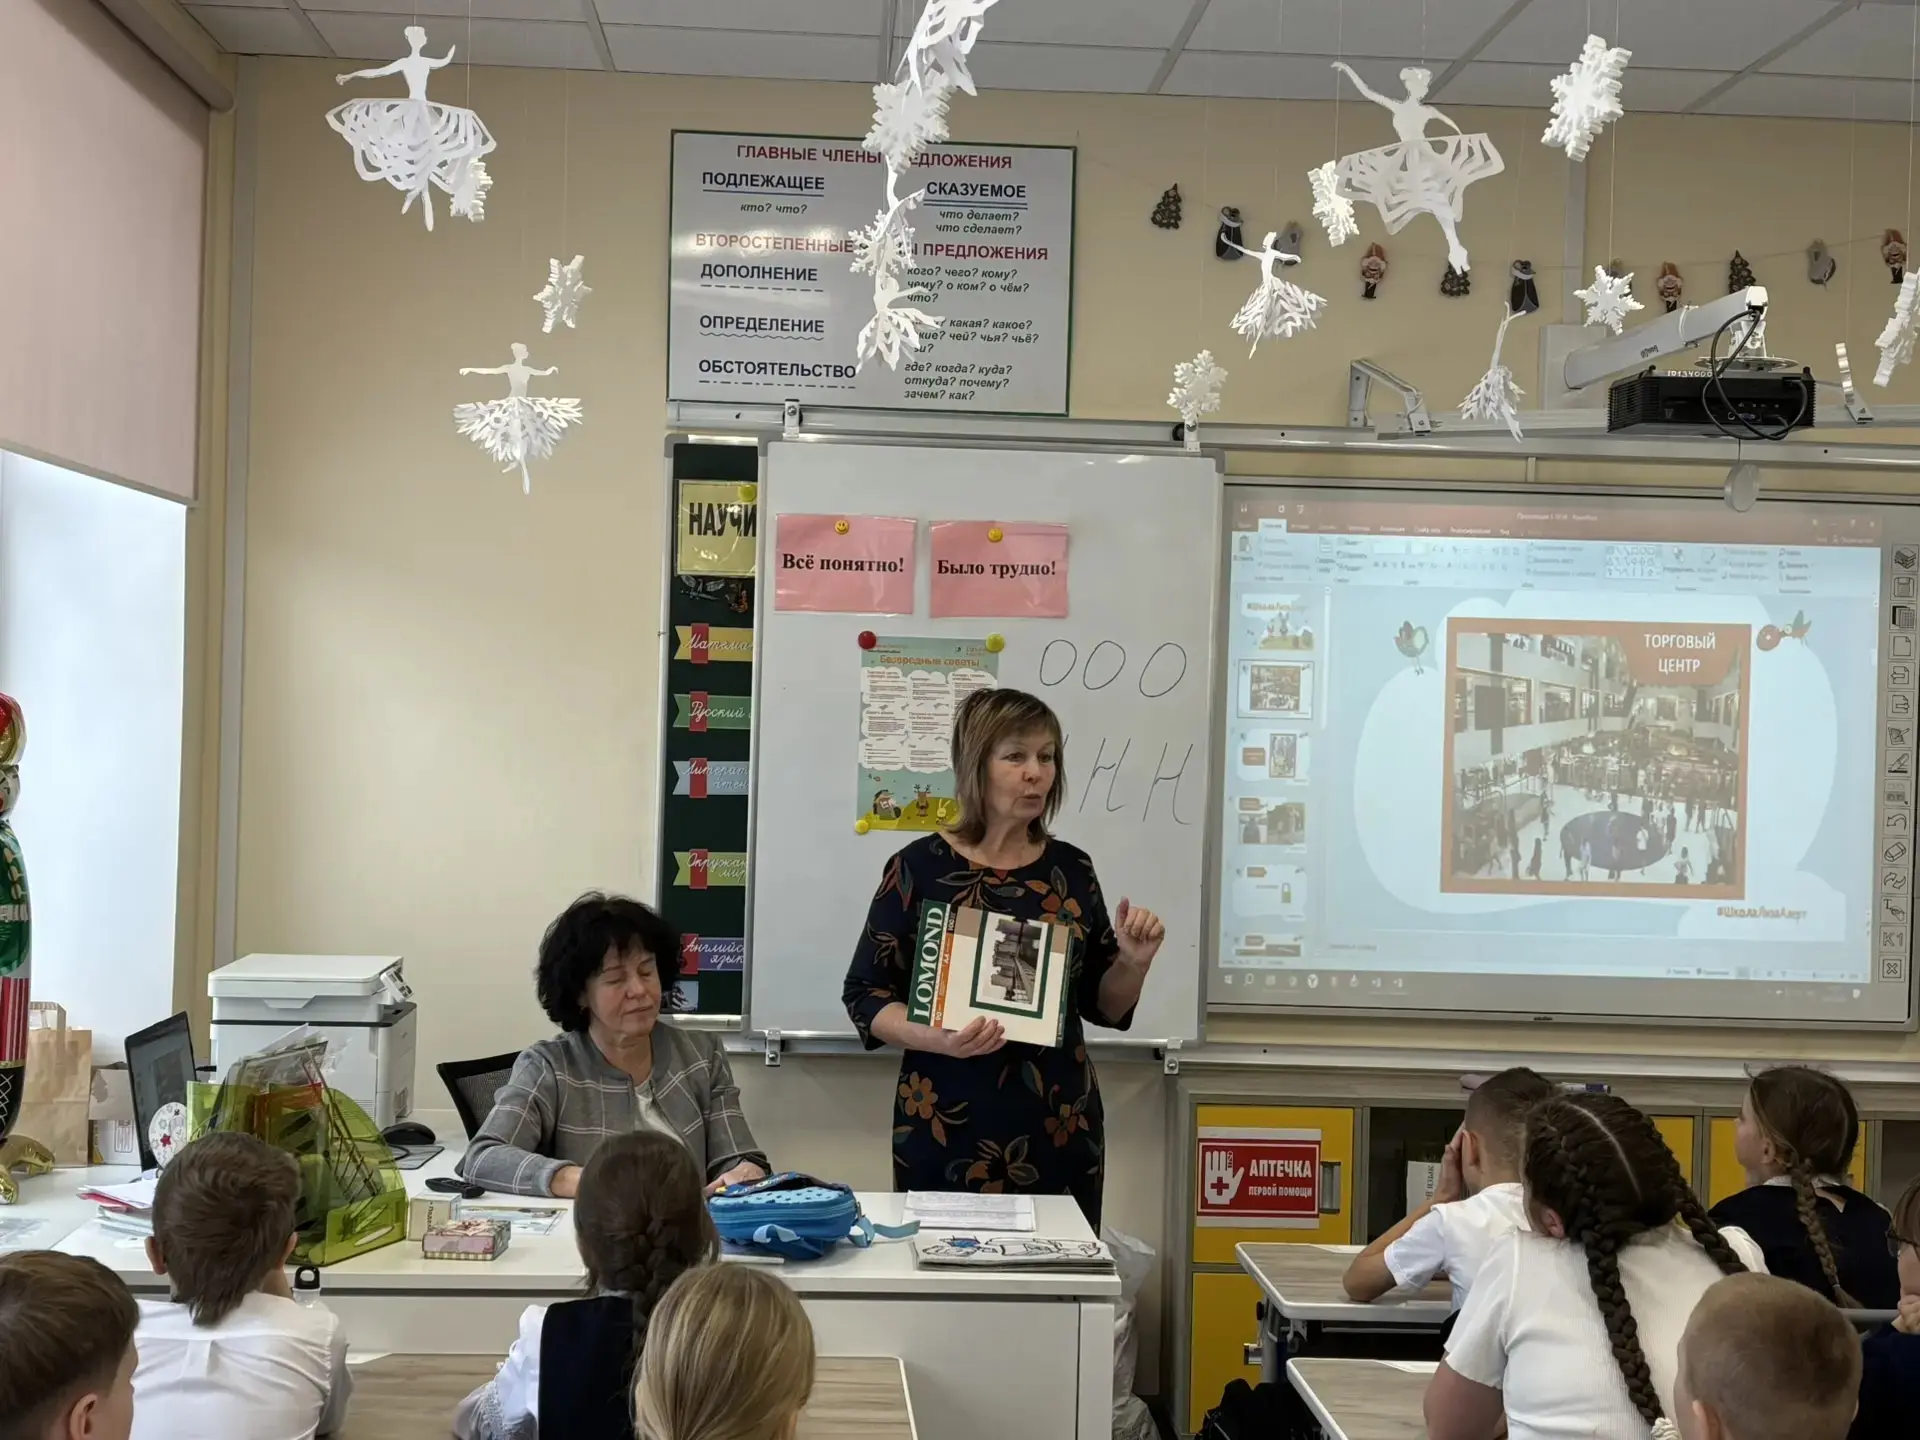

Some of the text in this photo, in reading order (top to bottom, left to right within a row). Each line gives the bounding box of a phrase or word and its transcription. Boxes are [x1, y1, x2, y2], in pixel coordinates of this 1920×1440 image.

[737, 145, 1012, 169] ГЛАВНЫЕ ЧЛЕНЫ ЕДЛОЖЕНИЯ
[702, 171, 825, 191] ПОДЛЕЖАЩЕЕ
[926, 181, 1026, 198] СКАЗУЕМОЕ
[740, 202, 808, 215] кто? что?
[939, 209, 1020, 222] что делает?
[935, 223, 1022, 235] что сделает?
[695, 233, 855, 253] ВТОРОСТЕПЕННЫЕ
[923, 243, 1048, 260] ПРЕДЛОЖЕНИЯ
[700, 263, 818, 281] ДОПОЛНЕНИЕ
[907, 266, 1018, 281] кого? чего? кому?
[907, 280, 943, 291] чему?
[956, 281, 987, 291] ком?
[1000, 283, 1030, 293] чём?
[907, 293, 939, 303] что?
[699, 314, 825, 333] ОПРЕДЕЛЕНИЕ
[949, 318, 990, 328] какая?
[992, 320, 1033, 330] какое?
[917, 331, 1040, 344] кие? чей? чья? чьё?
[698, 359, 857, 379] ОБСТОЯТЕЛЬСТВО
[904, 362, 1013, 377] где? когда? куда?
[904, 376, 1010, 390] откуда? почему?
[904, 389, 975, 401] зачем? как?
[782, 553, 905, 573] Всё понятно!
[936, 559, 1056, 579] Было трудно!
[1643, 632, 1716, 650] ТОРГОВЫЙ
[1658, 658, 1701, 676] ЦЕНТР
[688, 700, 745, 723] Русский
[913, 907, 944, 1019] LOMOND
[1249, 1158, 1312, 1179] АПТЕЧКА
[1248, 1183, 1313, 1199] ПЕРВОЙ ПОМОЩИ
